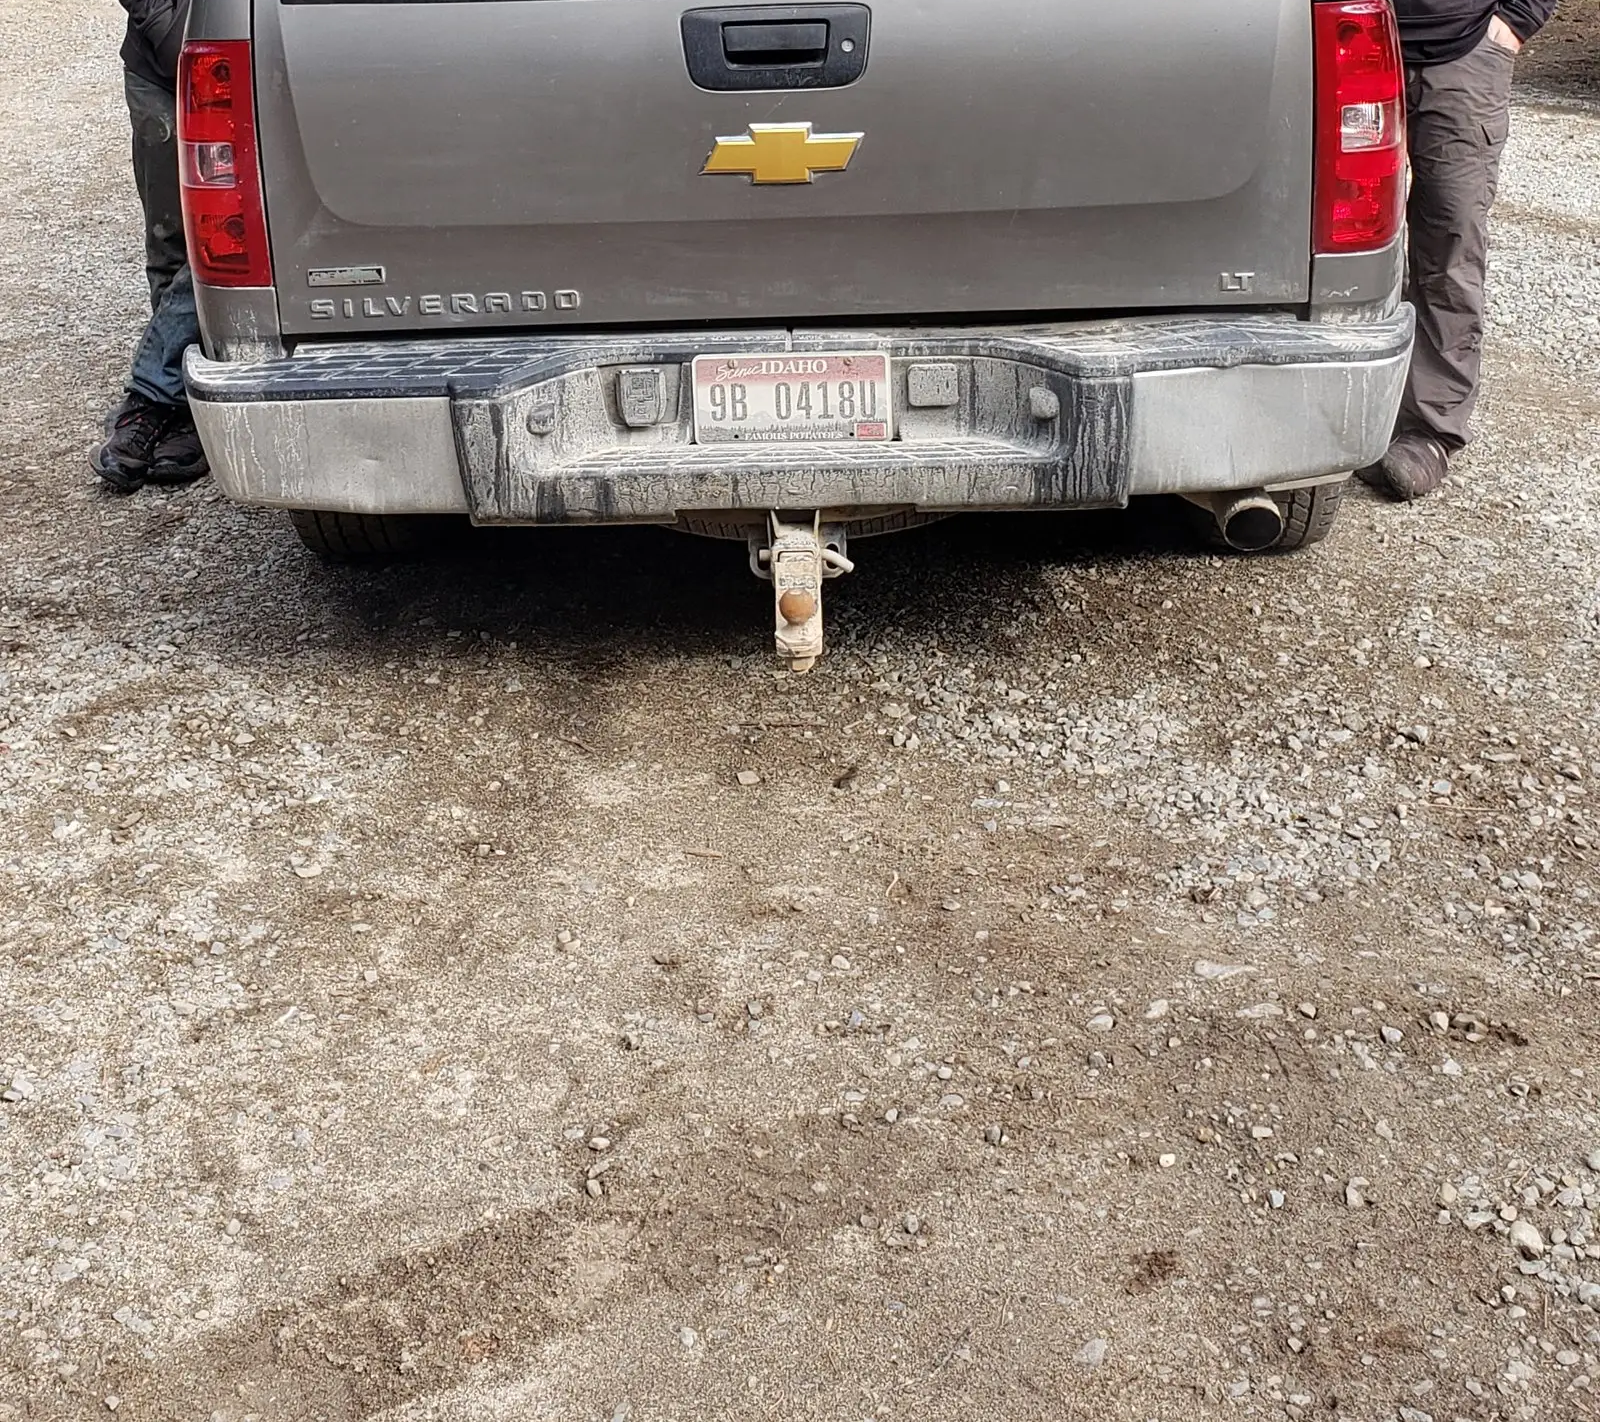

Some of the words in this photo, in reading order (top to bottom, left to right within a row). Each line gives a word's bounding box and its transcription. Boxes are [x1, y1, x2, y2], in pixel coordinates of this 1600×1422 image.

[1220, 272, 1255, 291] LT
[310, 289, 580, 319] SILVERADO
[715, 364, 761, 382] Scenic
[760, 359, 828, 375] IDAHO
[710, 383, 748, 421] 9B
[775, 380, 878, 420] 0418U
[745, 432, 787, 441] FAMOUS
[789, 431, 843, 440] POTATOES
